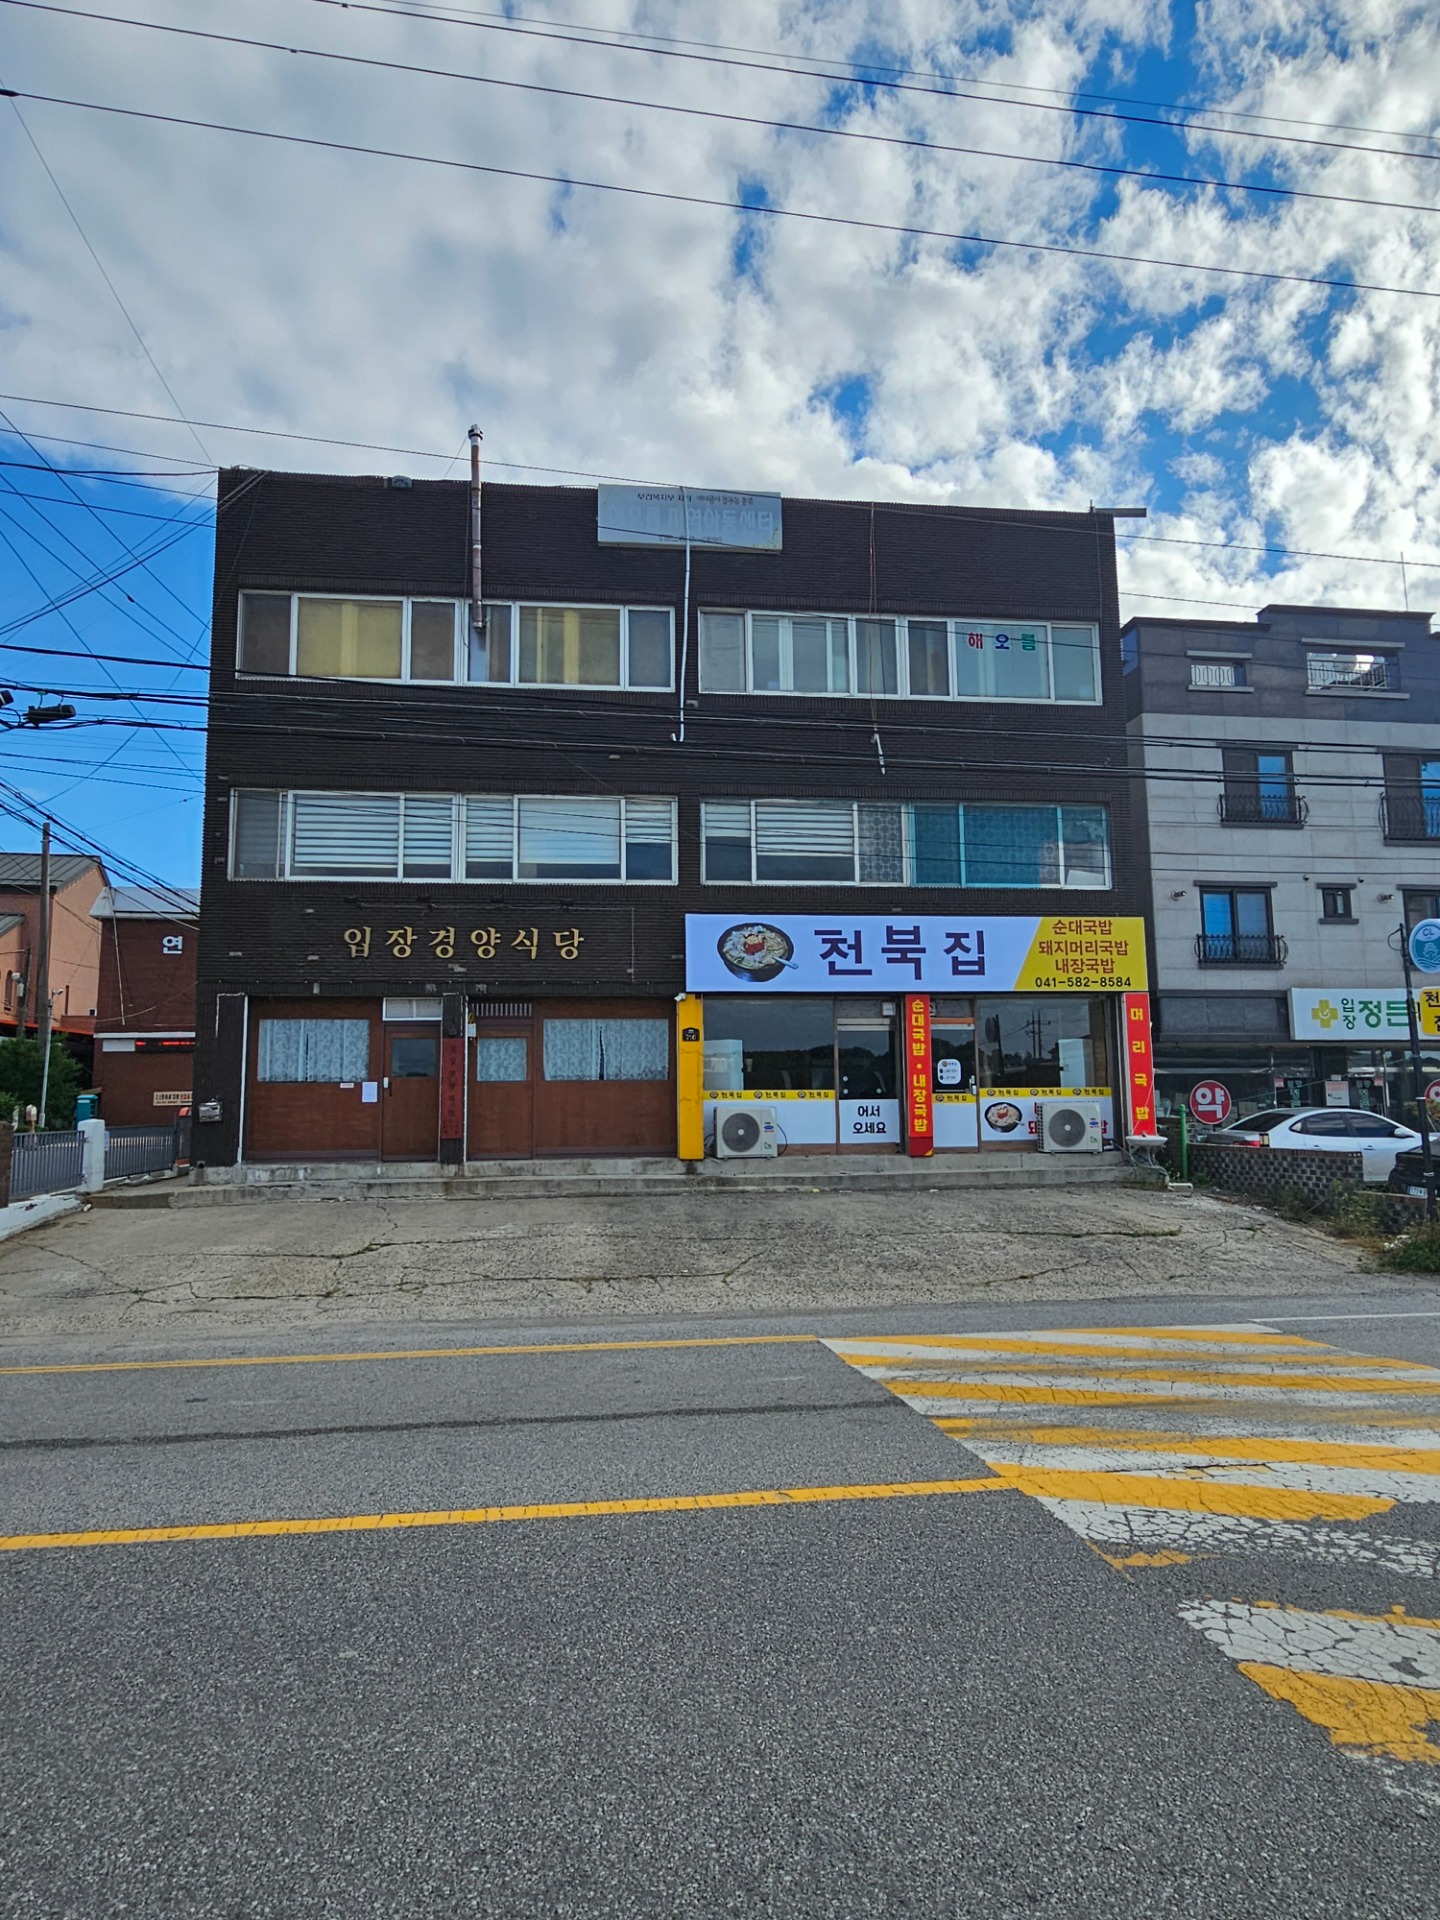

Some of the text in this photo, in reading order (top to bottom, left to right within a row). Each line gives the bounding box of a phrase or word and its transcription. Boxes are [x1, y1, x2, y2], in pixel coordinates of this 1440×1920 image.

[968, 632, 1036, 651] 해오름
[1052, 920, 1113, 935] 순대국밥
[344, 926, 585, 960] 입장경양식당
[1039, 940, 1129, 956] 돼지머리국밥
[814, 925, 985, 980] 천북집
[1055, 959, 1115, 974] 내장국밥
[1035, 976, 1131, 988] 041-582-8584
[1130, 1008, 1149, 1120] 머리국밥
[1195, 1087, 1225, 1119] 약
[857, 1105, 881, 1118] 어서
[852, 1121, 887, 1134] 오세요
